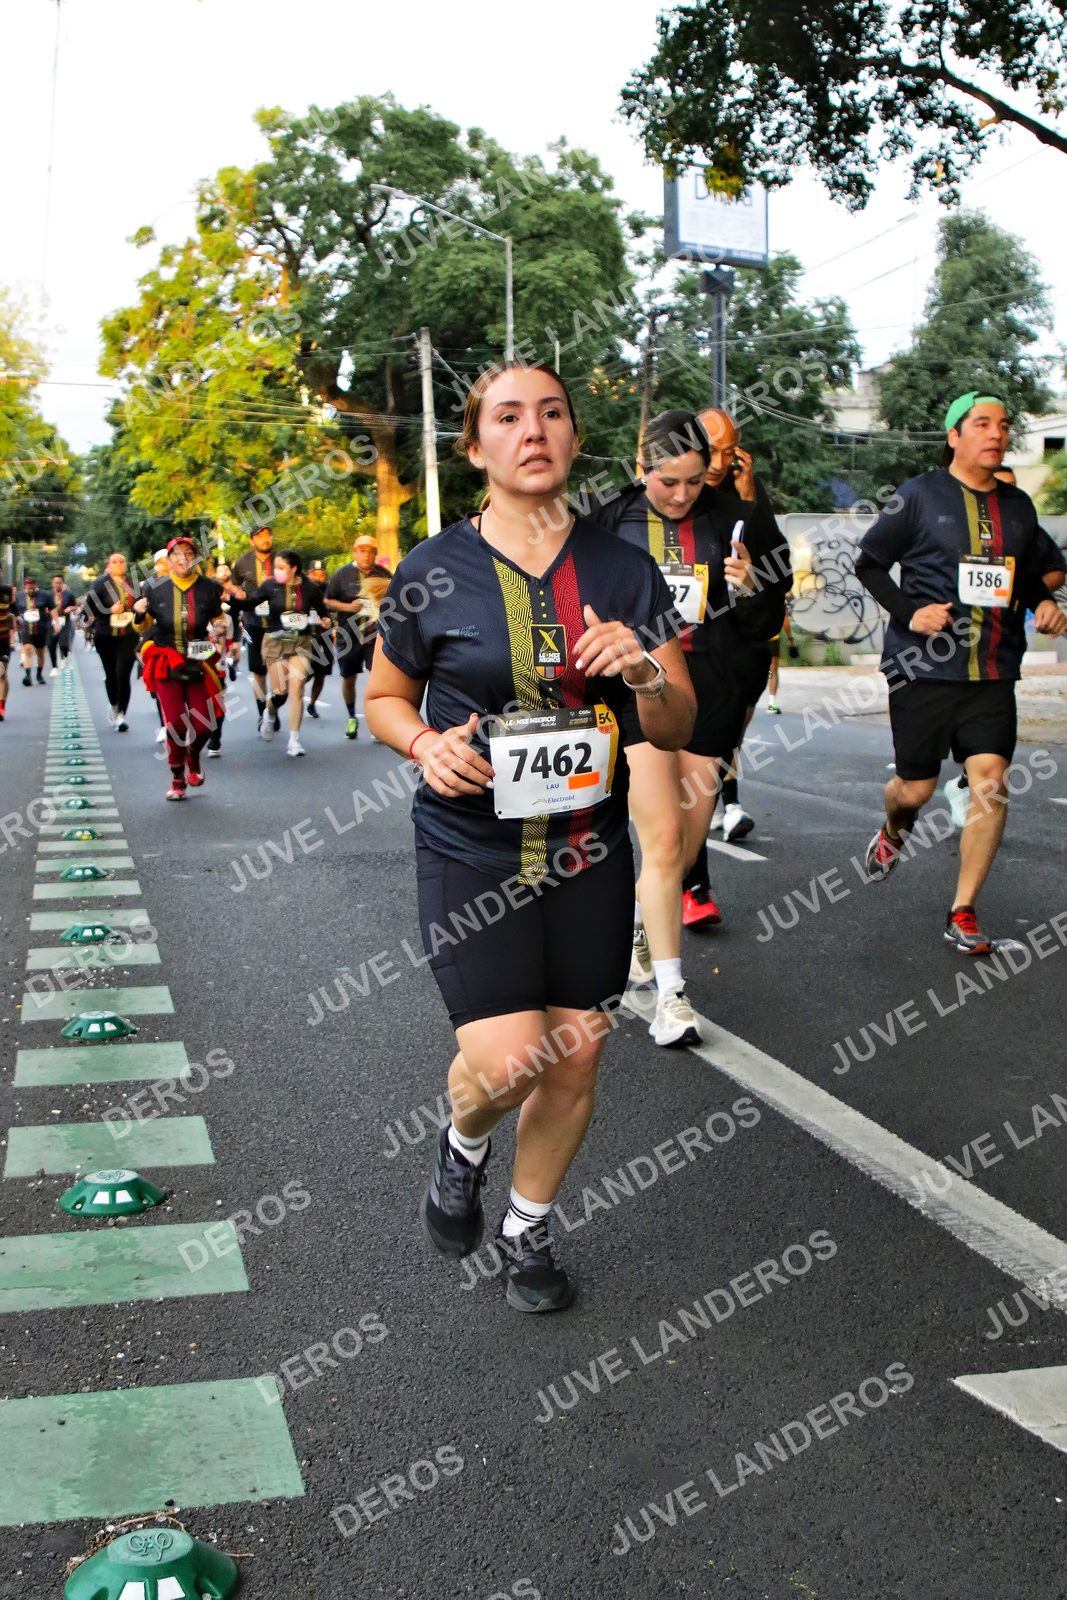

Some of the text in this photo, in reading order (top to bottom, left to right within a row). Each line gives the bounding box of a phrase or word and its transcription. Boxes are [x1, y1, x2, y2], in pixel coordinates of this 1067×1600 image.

[967, 570, 1002, 589] 1586
[598, 711, 612, 725] 5K
[508, 741, 593, 783] 7462
[547, 795, 576, 804] Electrolit
